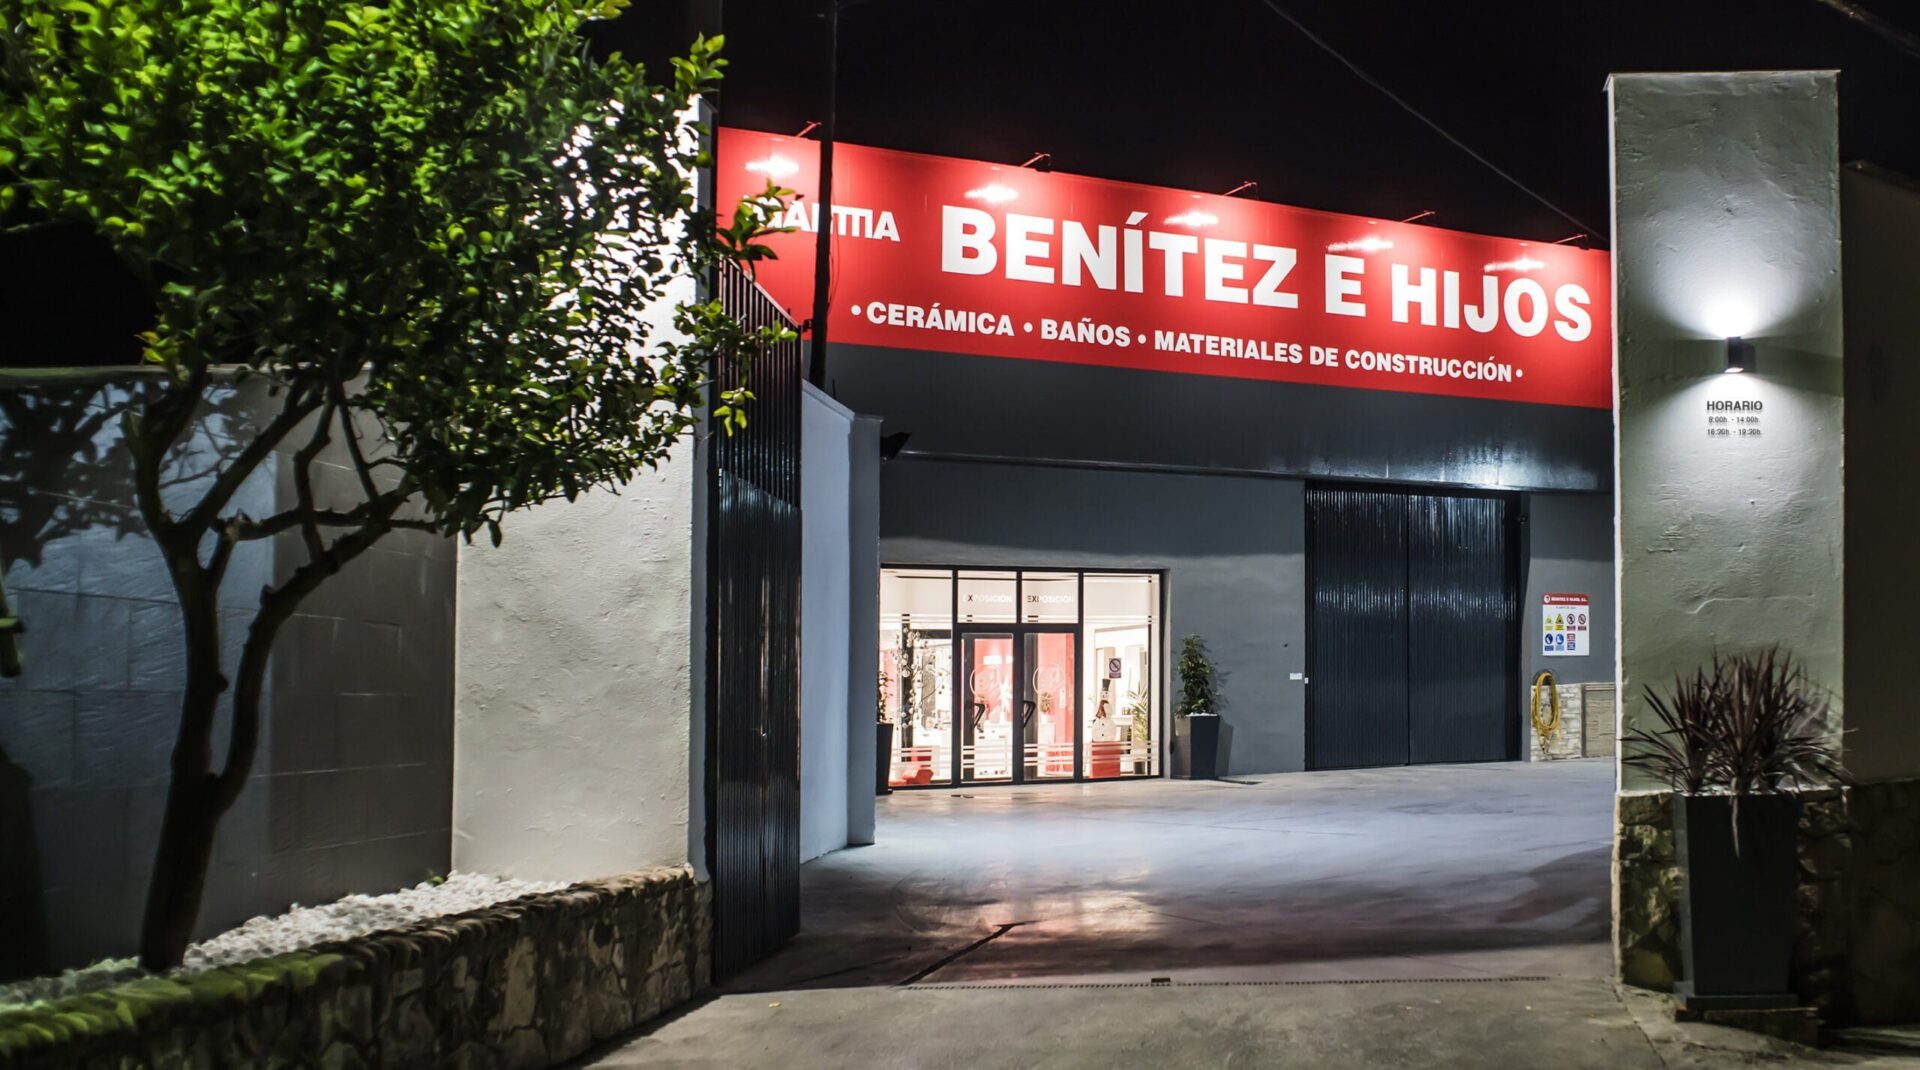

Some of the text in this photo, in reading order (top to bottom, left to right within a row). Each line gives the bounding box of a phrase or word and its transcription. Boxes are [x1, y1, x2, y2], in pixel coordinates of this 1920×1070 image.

[941, 204, 1592, 342] BENÍTEZ E HIJOS
[866, 301, 1512, 382] CERÁMICA BAÑOS MATERIALES DE CONSTRUCCIÓN
[1706, 400, 1763, 411] HORARIO
